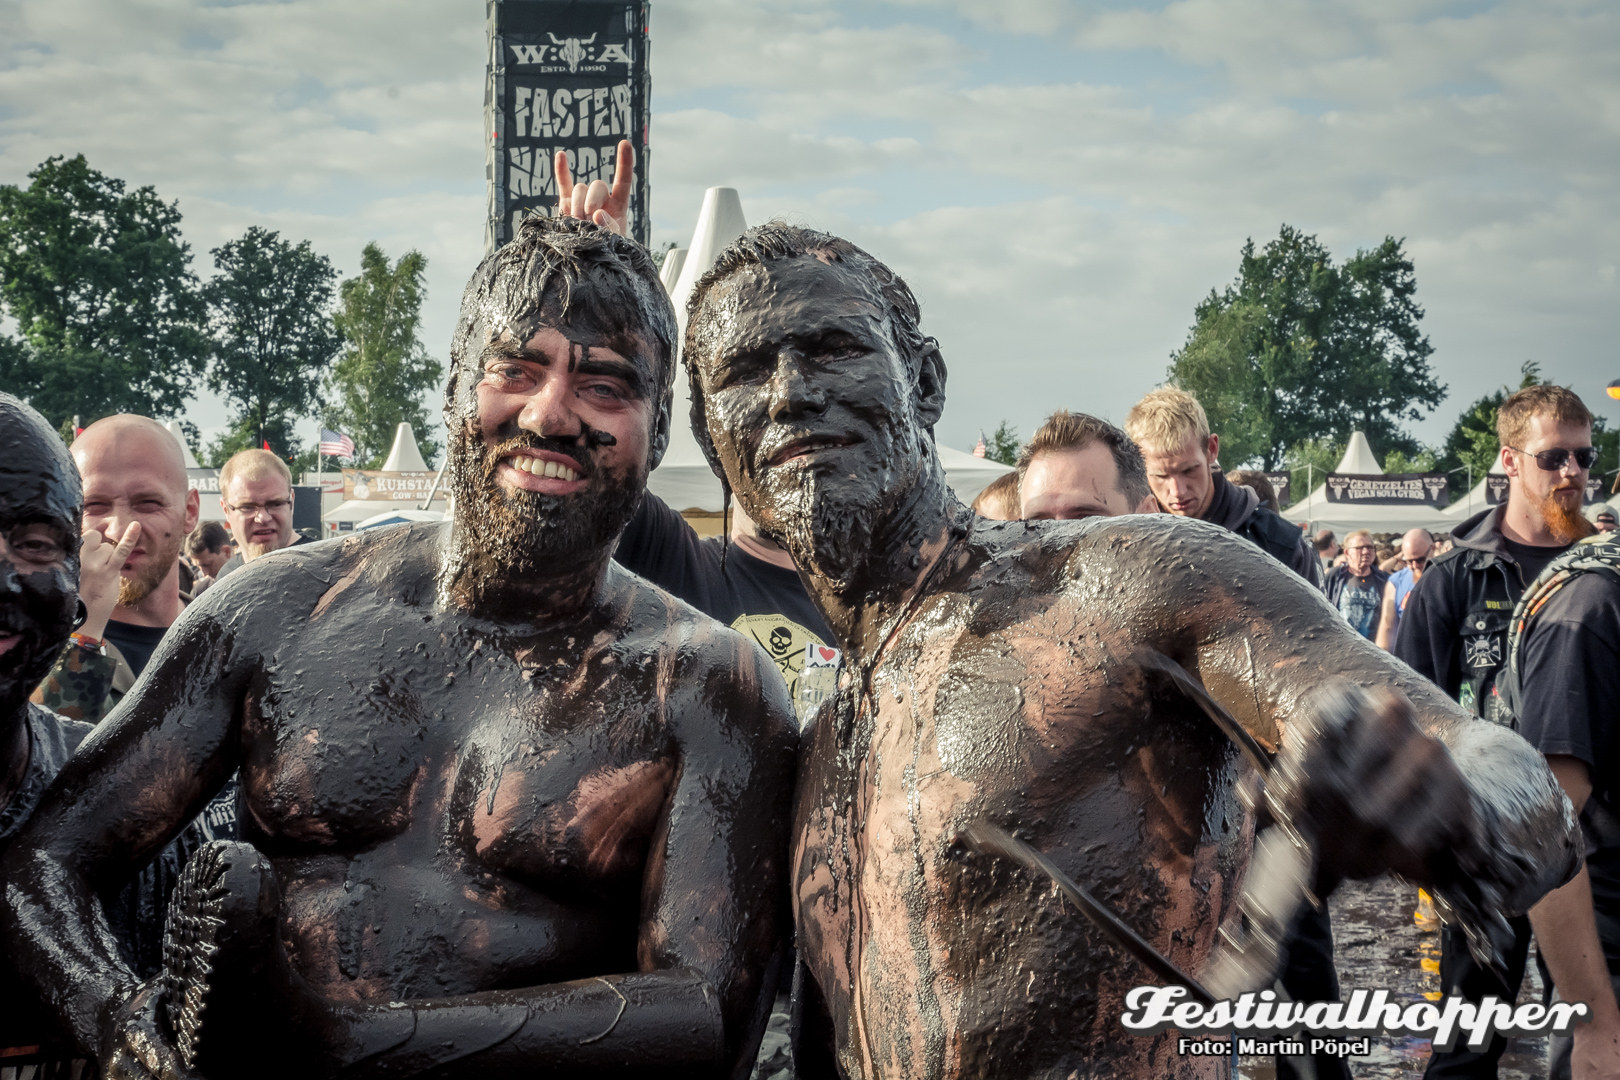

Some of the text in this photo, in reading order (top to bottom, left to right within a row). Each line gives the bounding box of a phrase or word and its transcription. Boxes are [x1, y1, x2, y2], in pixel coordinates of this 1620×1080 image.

[540, 64, 606, 73] ESTD. 1990
[515, 84, 632, 138] FASTER
[509, 146, 638, 200] HARDE
[188, 478, 218, 491] BAR
[1347, 489, 1425, 500] VEGAN SOYA GYROS
[809, 643, 813, 659] I
